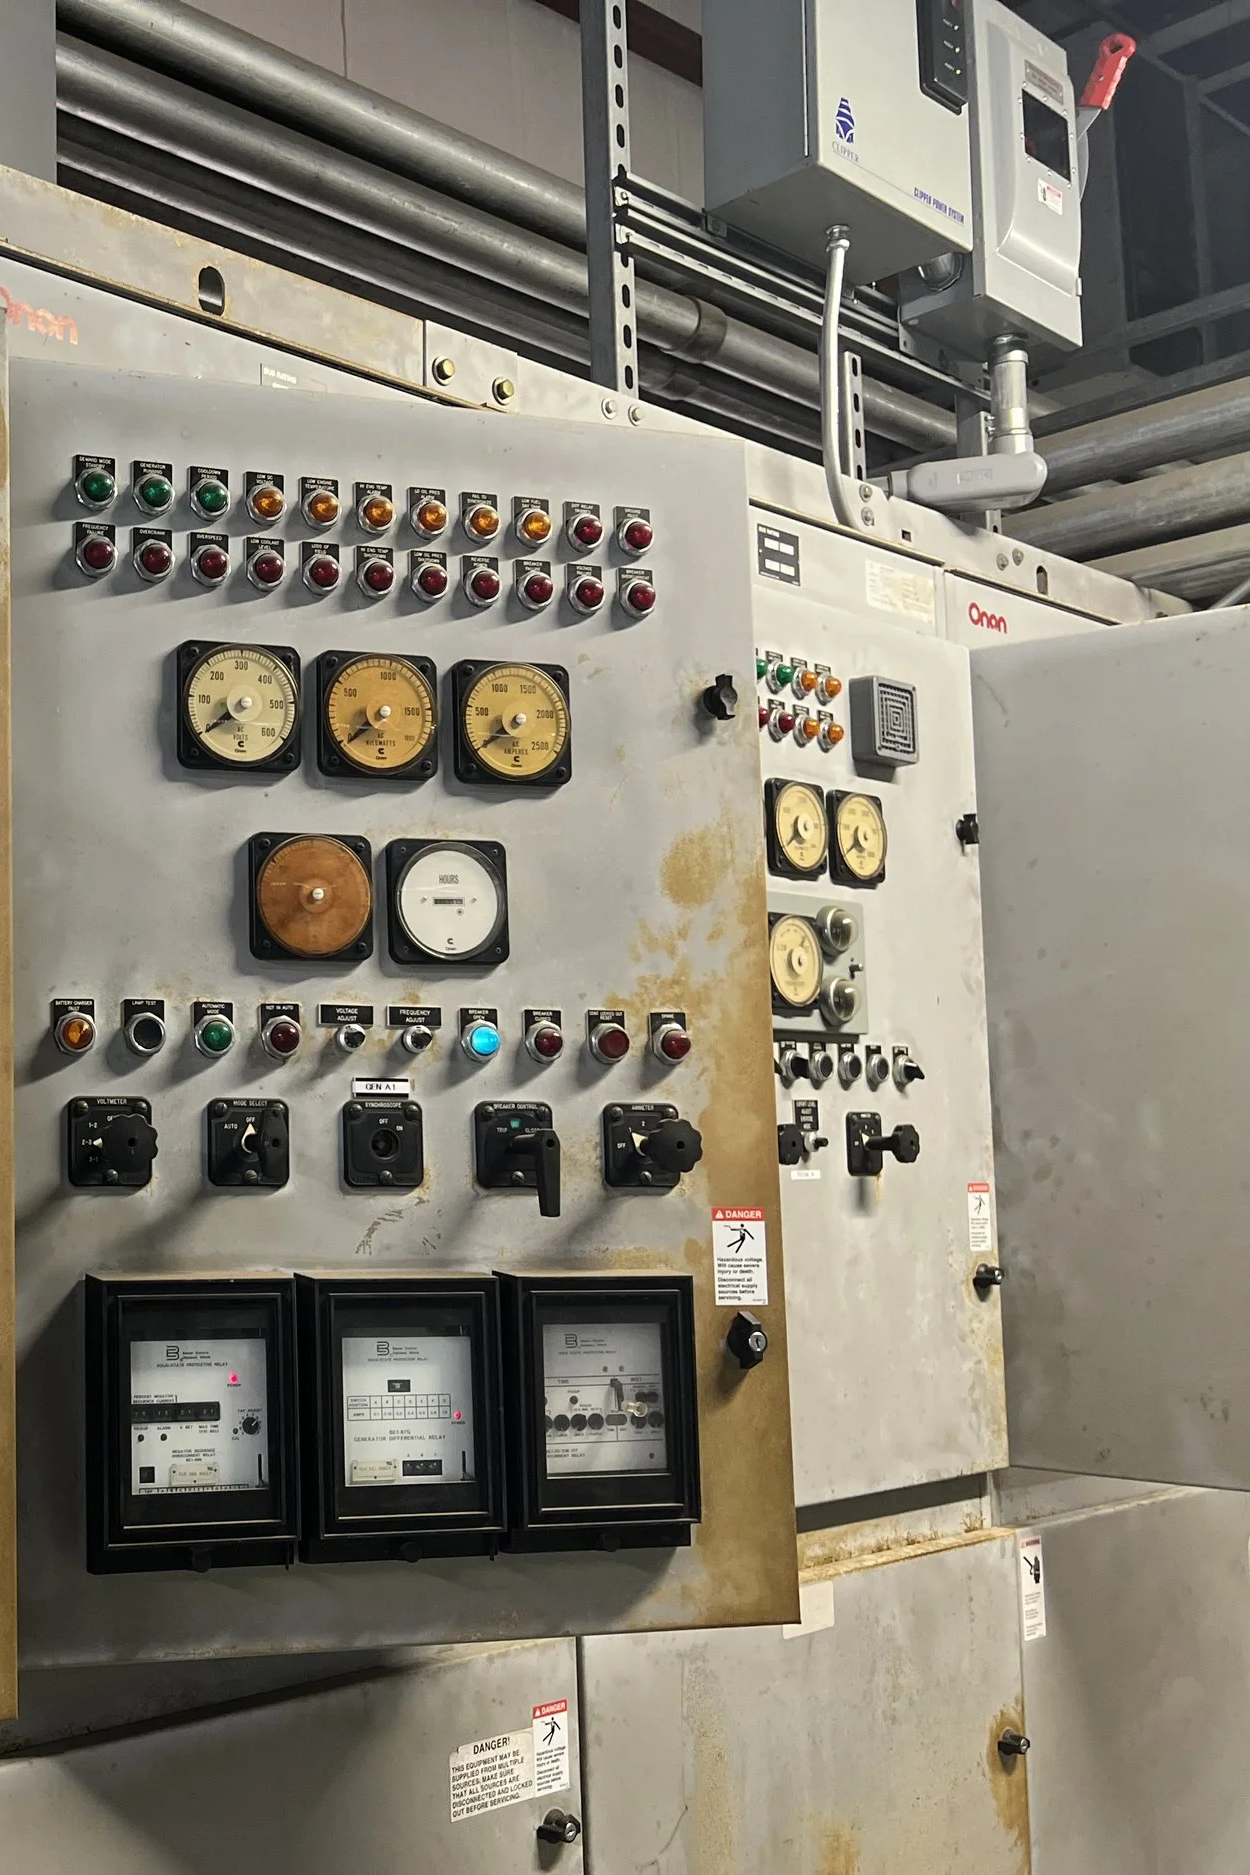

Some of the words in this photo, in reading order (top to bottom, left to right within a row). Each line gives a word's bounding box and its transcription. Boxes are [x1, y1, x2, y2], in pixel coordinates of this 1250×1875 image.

[832, 141, 859, 162] CLIPPER
[914, 187, 931, 204] CLIPPER
[933, 198, 947, 214] POWER
[949, 207, 964, 223] SYSTEM
[968, 602, 1007, 634] Onan
[235, 661, 248, 670] 300
[210, 671, 224, 681] 200
[258, 675, 272, 685] 400
[380, 672, 396, 681] 1000
[343, 688, 357, 698] 500
[492, 684, 508, 693] 1000
[520, 685, 536, 694] 1500
[198, 695, 211, 704] 100
[270, 700, 284, 709] 500
[404, 707, 420, 716] 1500
[475, 707, 488, 716] 500
[537, 710, 554, 719] 2000
[261, 727, 275, 737] 600
[532, 742, 549, 750] 2500
[439, 875, 459, 884] HOURS
[365, 1083, 382, 1091] GEN
[385, 1083, 396, 1091] A1
[726, 1210, 762, 1218] DANGER
[541, 1702, 566, 1714] DANGER
[473, 1736, 510, 1754] DANGER!
[452, 1764, 464, 1774] THIS
[466, 1756, 498, 1771] EQUIPMENT
[499, 1753, 511, 1761] MAY
[452, 1770, 479, 1782] SUPPLIED
[481, 1764, 496, 1774] FROM
[498, 1757, 524, 1769] MULTIPLE
[482, 1774, 498, 1783] MAKE
[499, 1768, 514, 1778] SURE
[452, 1790, 467, 1800] THAT
[469, 1787, 479, 1795] ALL
[481, 1779, 507, 1792] SOURCES
[508, 1775, 519, 1784] ARE
[453, 1791, 496, 1809] DISCONNECTED
[498, 1788, 509, 1796] AND
[510, 1780, 532, 1792] LOCKED
[453, 1809, 464, 1818] OUT
[466, 1801, 488, 1814] BEFORE
